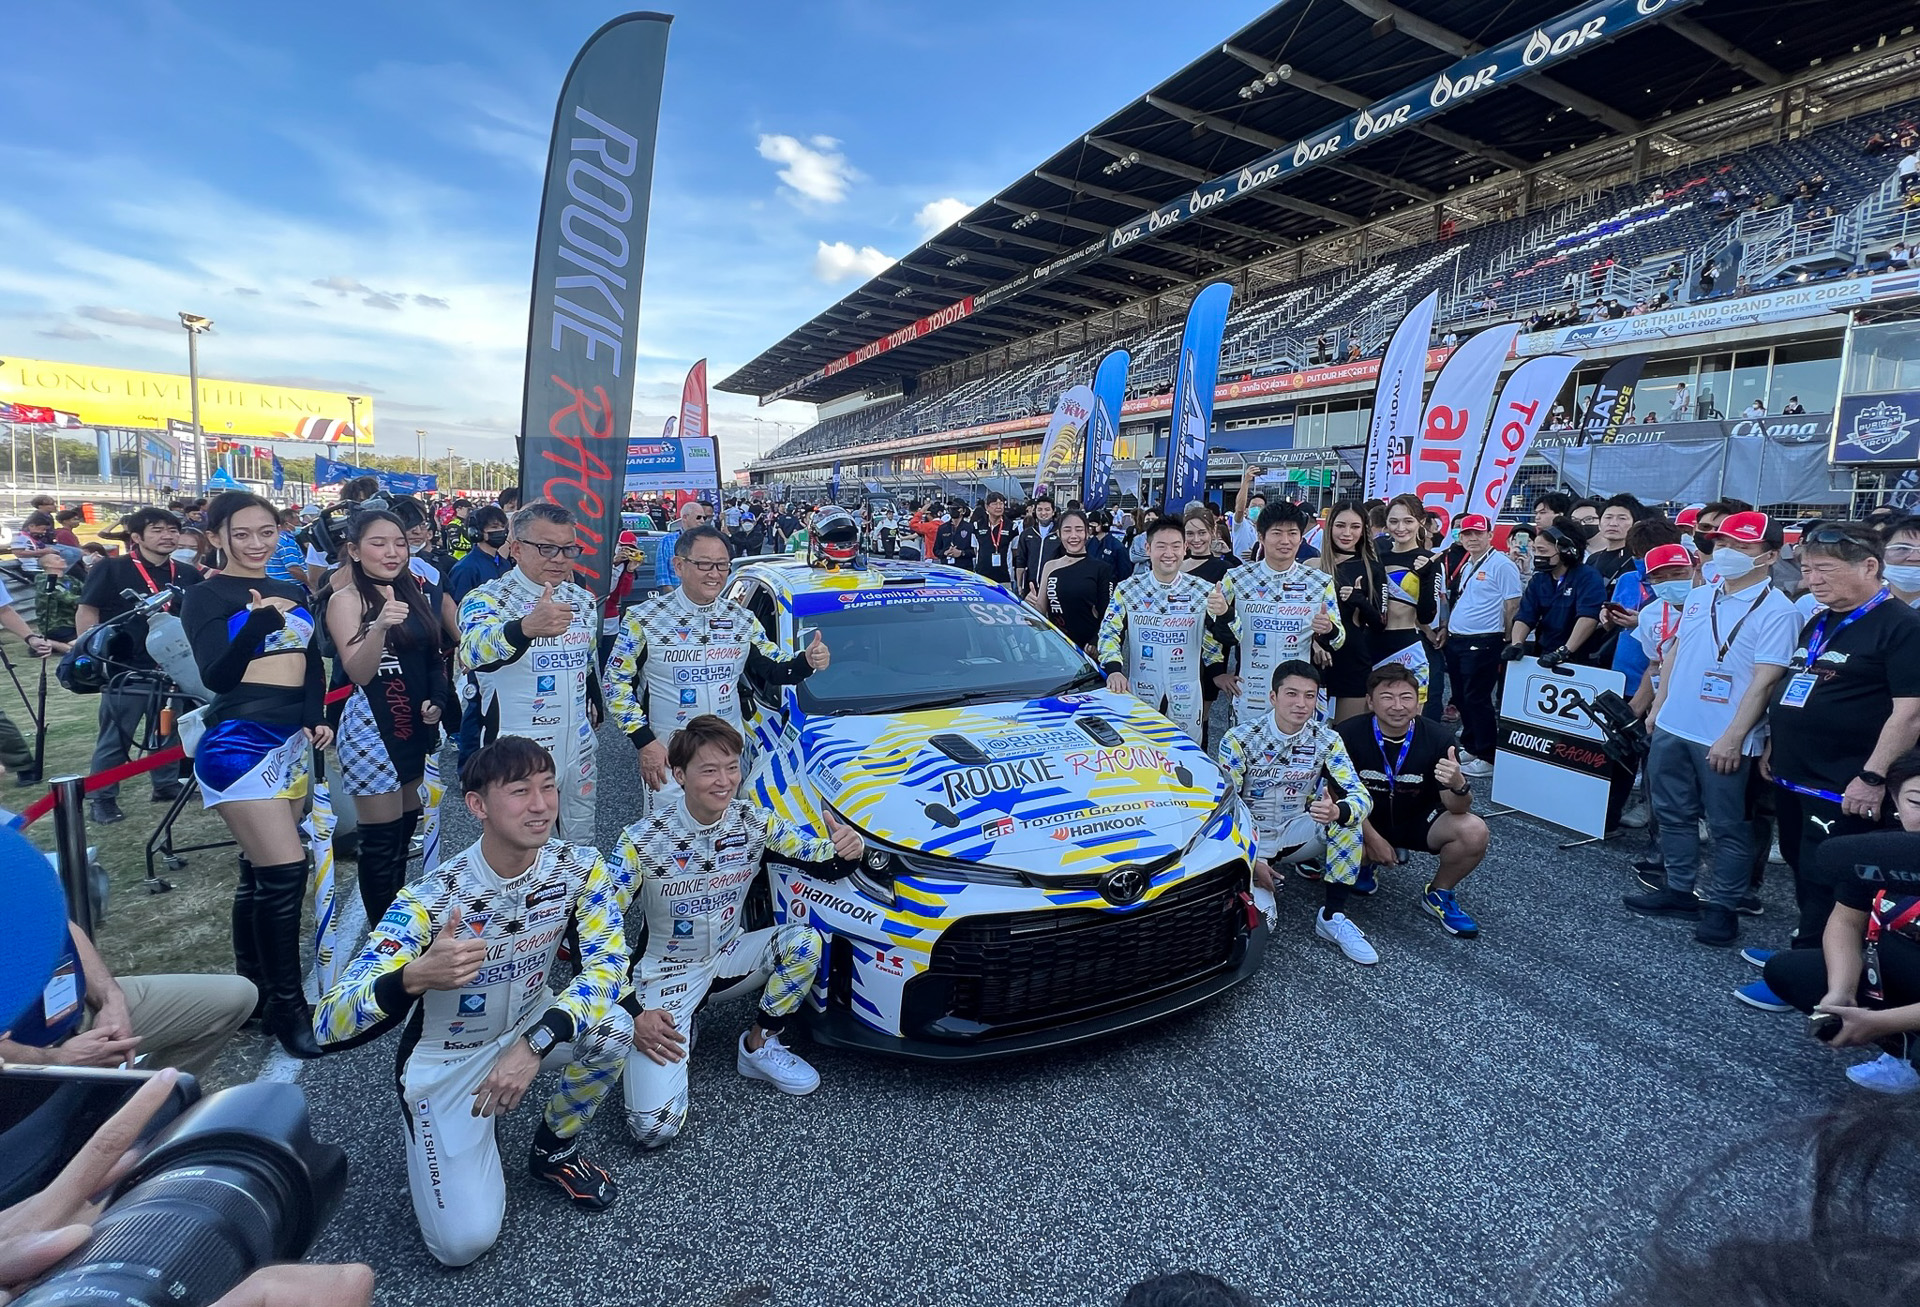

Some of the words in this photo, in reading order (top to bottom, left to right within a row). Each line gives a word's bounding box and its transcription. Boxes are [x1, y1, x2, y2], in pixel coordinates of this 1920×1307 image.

[1550, 16, 1607, 56] OR
[1451, 65, 1498, 99] OR
[1373, 105, 1411, 134] OR
[1308, 135, 1341, 161] OR
[1252, 164, 1280, 187] OR
[1200, 188, 1226, 208] OR
[1158, 208, 1180, 227] OR
[550, 105, 639, 377] ROOKIE
[1050, 248, 1085, 270] INTERNATIONAL
[1085, 239, 1106, 256] CIRCUIT
[927, 301, 966, 331] TOYOTA
[1632, 318, 1648, 329] OR
[1651, 308, 1716, 327] THAILAND
[1721, 298, 1772, 315] GRAND
[1775, 290, 1813, 306] PRIX
[1815, 283, 1861, 299] 2022
[888, 321, 917, 349] TOYOTA
[1677, 322, 1696, 330] OCT
[1697, 318, 1722, 327] 2022
[855, 341, 880, 363] TOYOTA
[829, 356, 849, 375] TOYOTA
[1307, 373, 1321, 383] PUT
[1322, 371, 1337, 380] OUR
[21, 368, 111, 393] LONG
[260, 394, 321, 413] KING
[1731, 421, 1818, 442] Chang
[1859, 416, 1901, 432] BURIRAM
[1207, 457, 1235, 466] CIRCUIT
[844, 600, 882, 610] SUPER
[886, 596, 959, 606] ENDURANCE
[861, 590, 916, 601] idemitsu
[1047, 577, 1063, 614] ROOKIE
[1133, 615, 1161, 626] ROOKIE
[1163, 617, 1195, 627] RACING
[1245, 603, 1276, 614] ROOKIE
[1278, 606, 1311, 616] RACING
[664, 649, 703, 662] ROOKIE
[706, 647, 741, 661] RACING
[692, 666, 731, 675] OGURA
[692, 673, 730, 682] CLUTCH
[382, 678, 413, 741] RACING
[1538, 684, 1581, 720] 32
[1007, 730, 1077, 742] OGURA
[1014, 736, 1083, 748] CLUTCH
[1508, 731, 1554, 754] ROOKIE
[1554, 743, 1607, 767] RACING
[942, 756, 1063, 807] ROOKIE
[1064, 747, 1174, 777] RACING
[984, 823, 1014, 839] GR
[1019, 810, 1085, 829] TOYOTA
[1089, 802, 1142, 815] GAZOO
[1144, 799, 1189, 808] Racing
[661, 878, 705, 897] ROOKIE
[708, 868, 753, 891] RACING
[691, 891, 738, 907] OGURA
[514, 925, 564, 956] RACING
[487, 958, 546, 983] CLUTCH
[488, 952, 547, 975] OGURA
[875, 963, 903, 977] Kawasaki
[421, 1120, 441, 1187] H.ISHIURA
